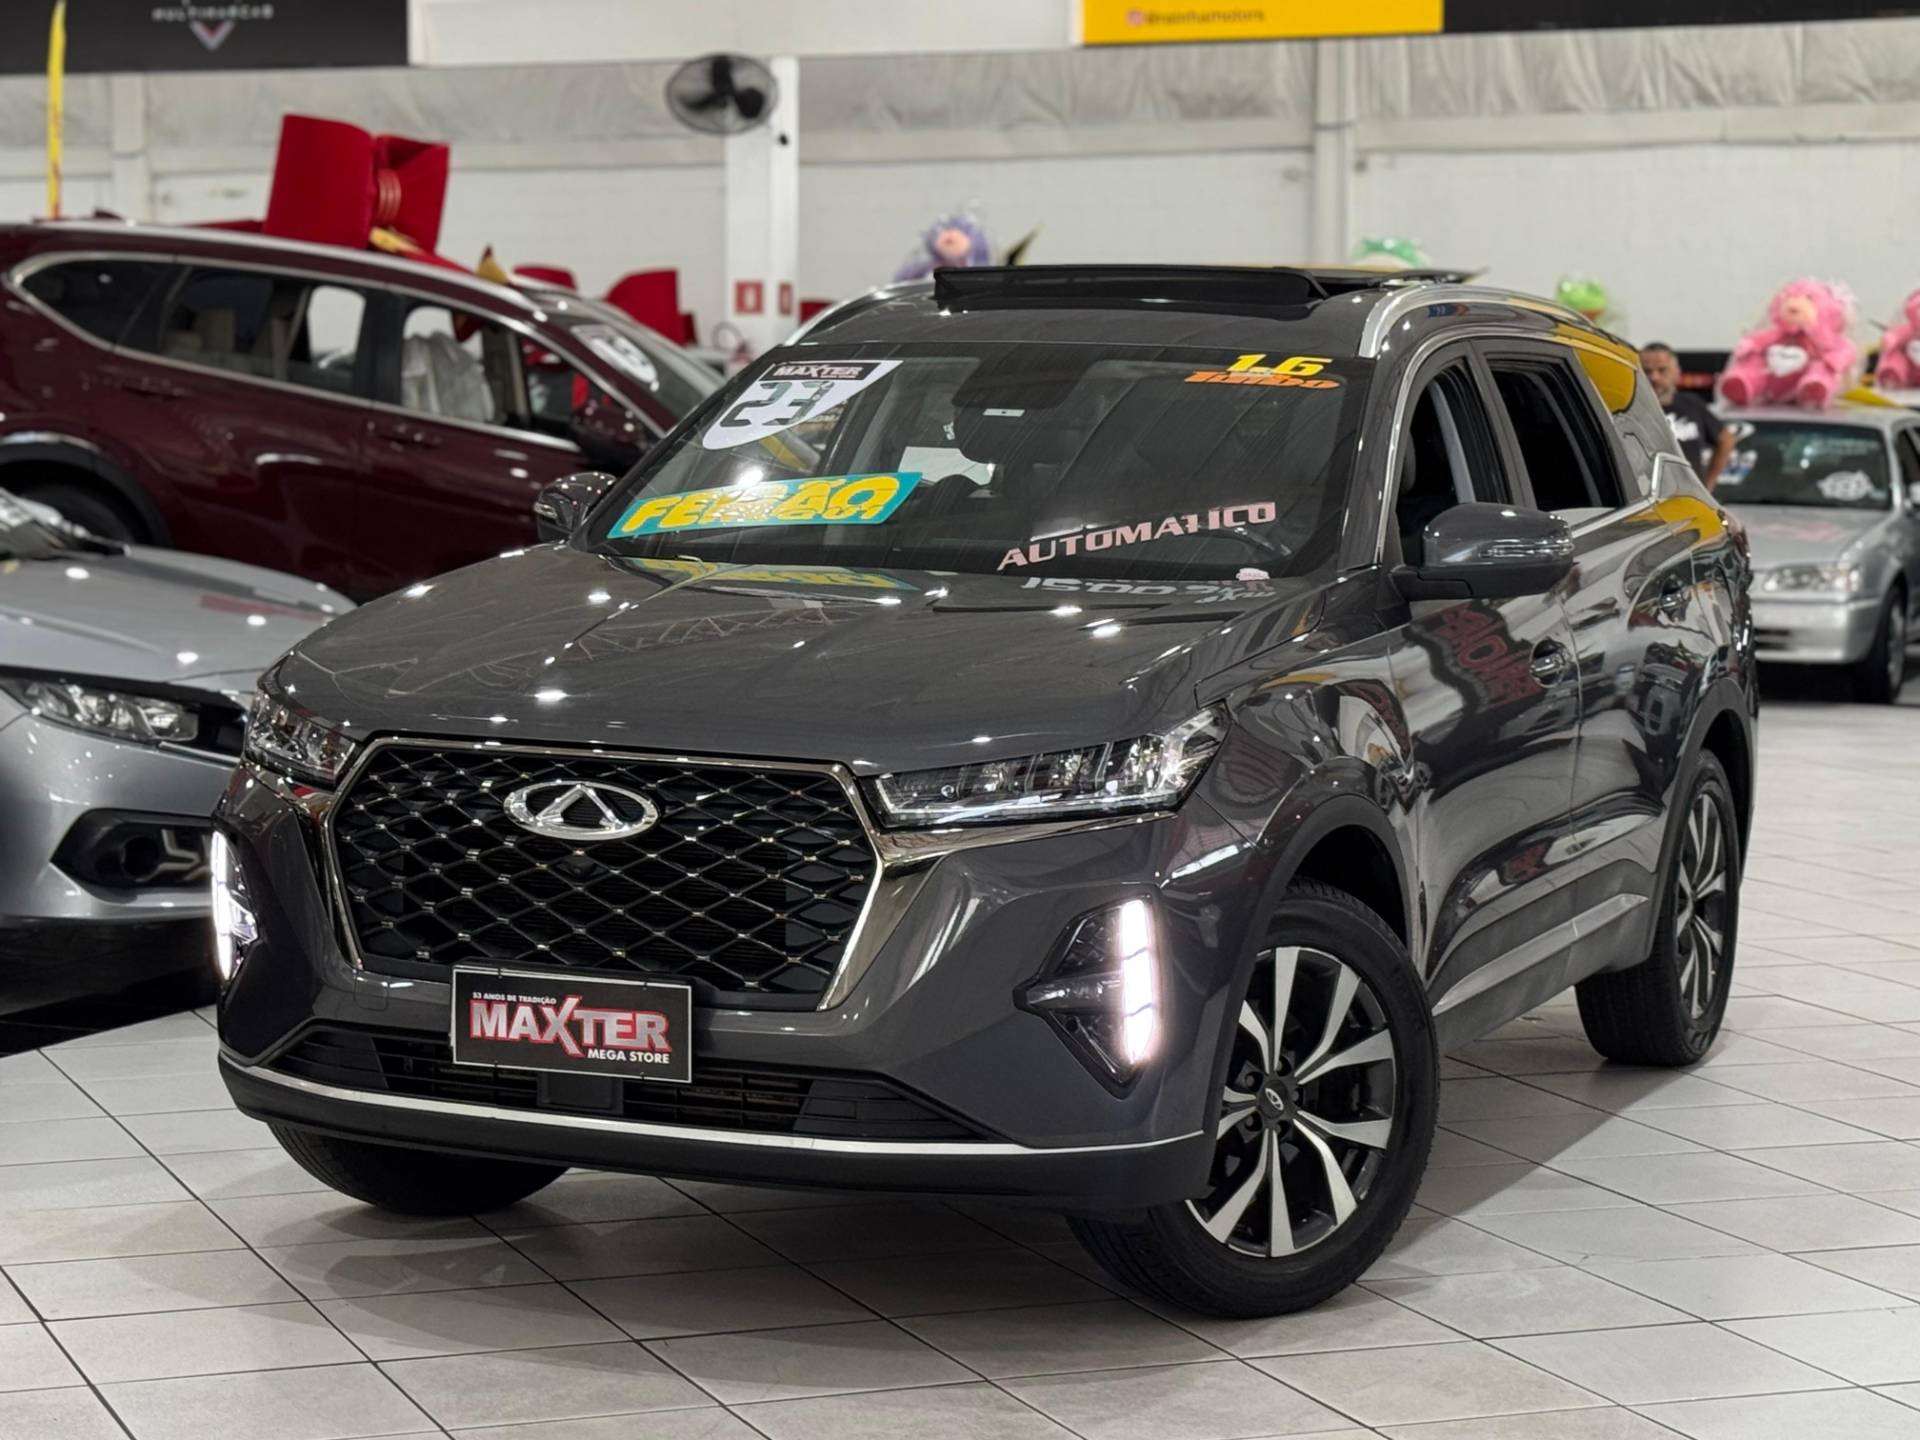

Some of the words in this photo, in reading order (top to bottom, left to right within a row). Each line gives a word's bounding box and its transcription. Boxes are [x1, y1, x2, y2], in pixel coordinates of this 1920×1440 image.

[773, 364, 864, 378] MAXTER
[720, 381, 835, 427] 23
[483, 993, 506, 1001] ANOS
[506, 994, 517, 1002] DE
[470, 994, 672, 1058] MAXTER
[587, 1048, 627, 1061] MEGA
[629, 1051, 670, 1064] STORE
